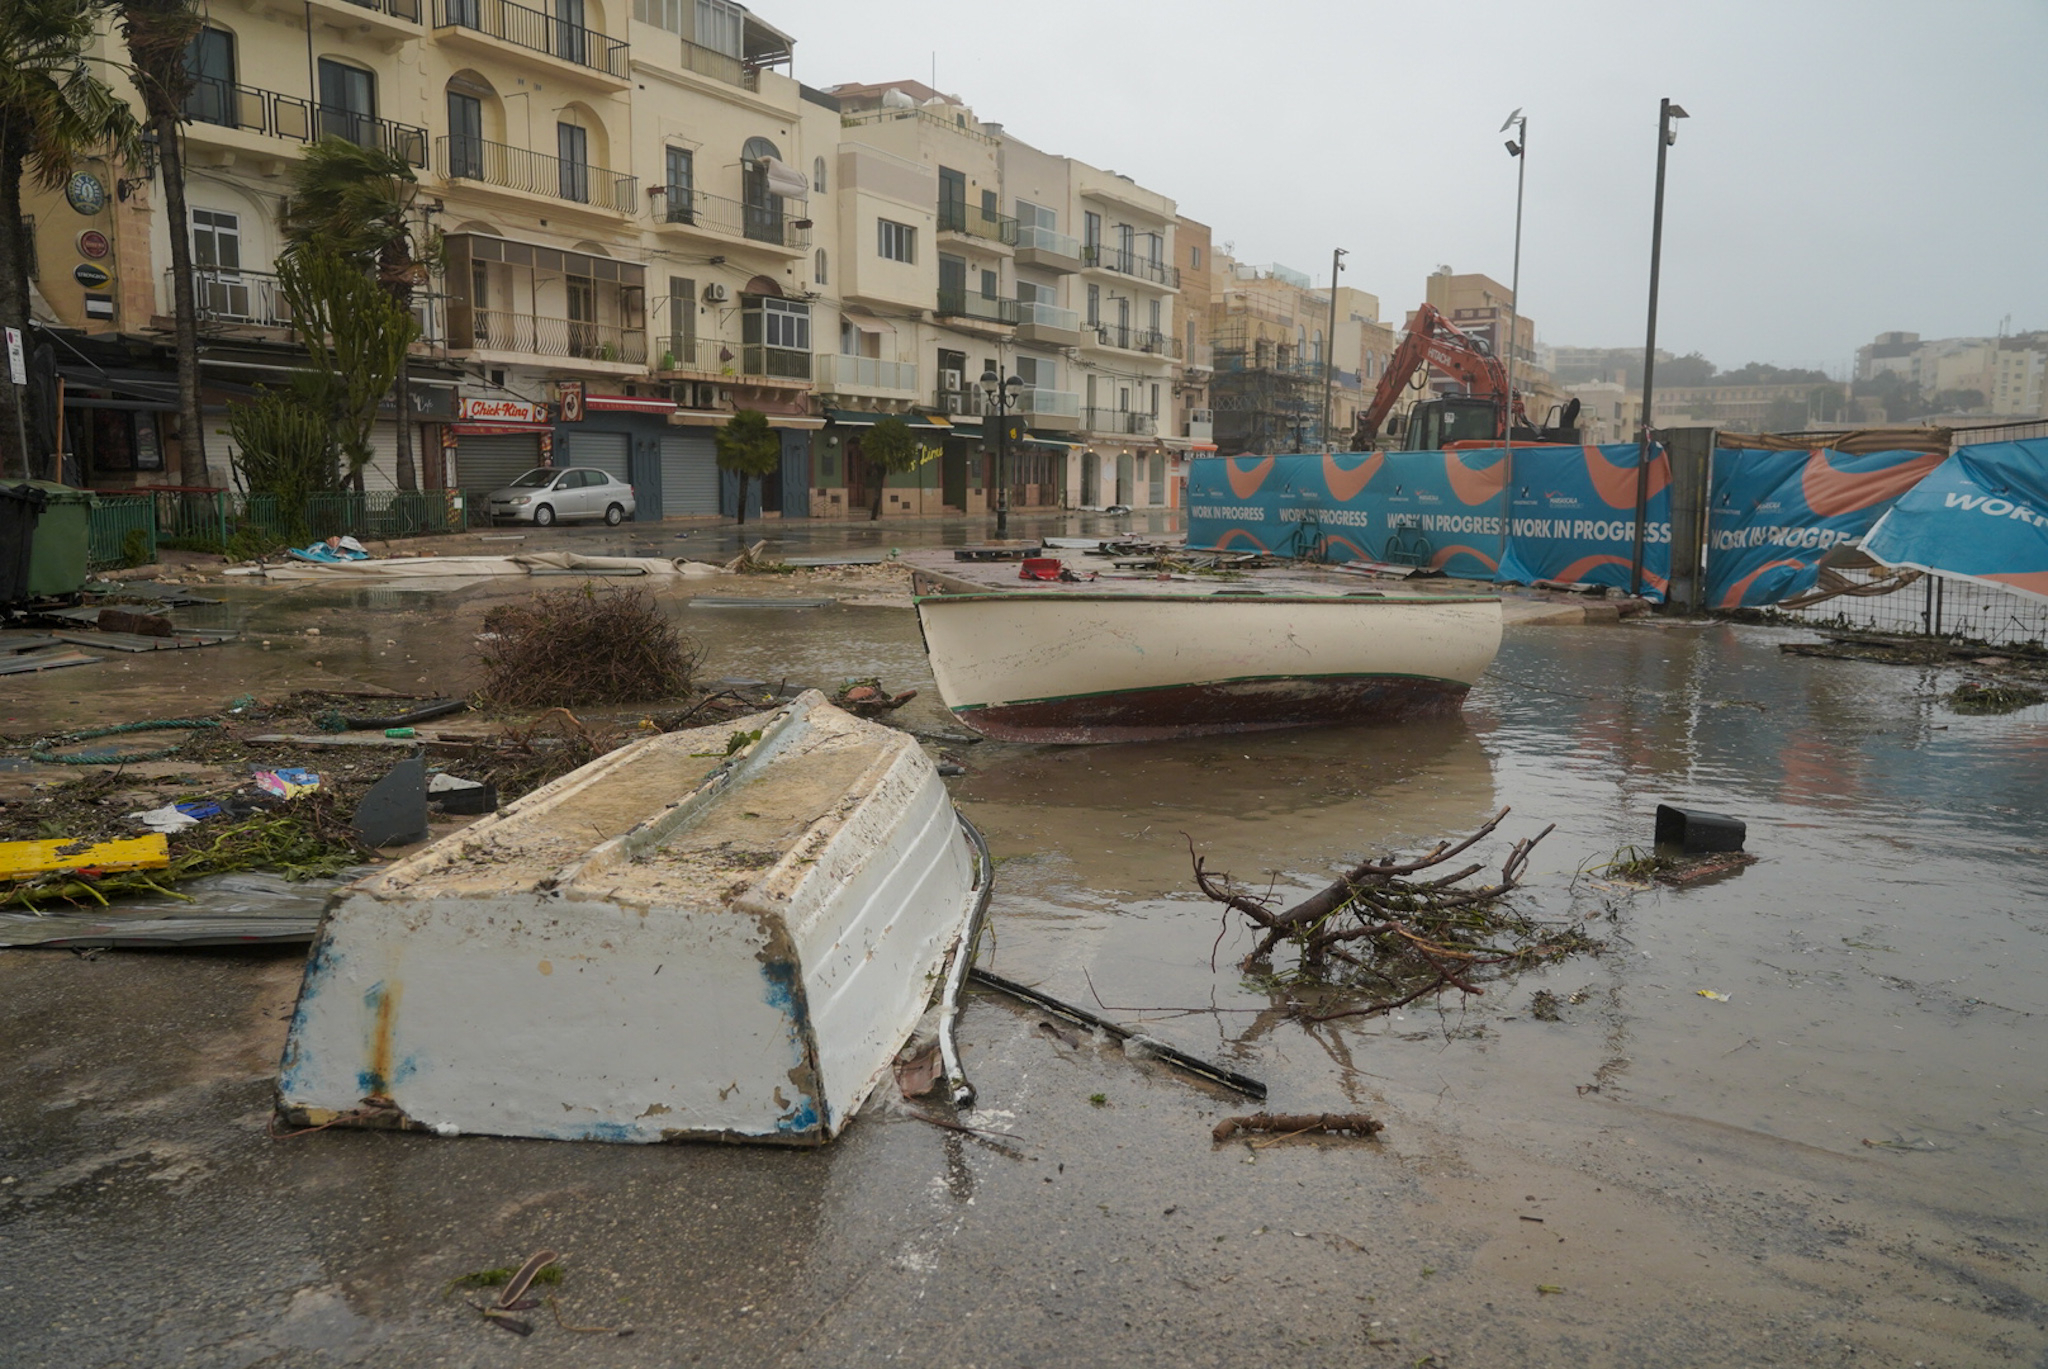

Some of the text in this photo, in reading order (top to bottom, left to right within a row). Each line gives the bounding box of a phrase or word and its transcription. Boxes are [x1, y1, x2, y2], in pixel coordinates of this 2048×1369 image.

[1428, 346, 1452, 367] HITACHI
[471, 401, 529, 419] Chick-King
[1191, 505, 1265, 521] WORK IN PROGRESS
[1279, 507, 1306, 522] WORK
[1319, 508, 1368, 528] PROGRESS
[1387, 512, 1509, 536] WORK IN PROGRESS
[1511, 518, 1551, 539] WORK
[1553, 519, 1571, 539] IN
[1711, 526, 1857, 550] WORK IN PROGRE
